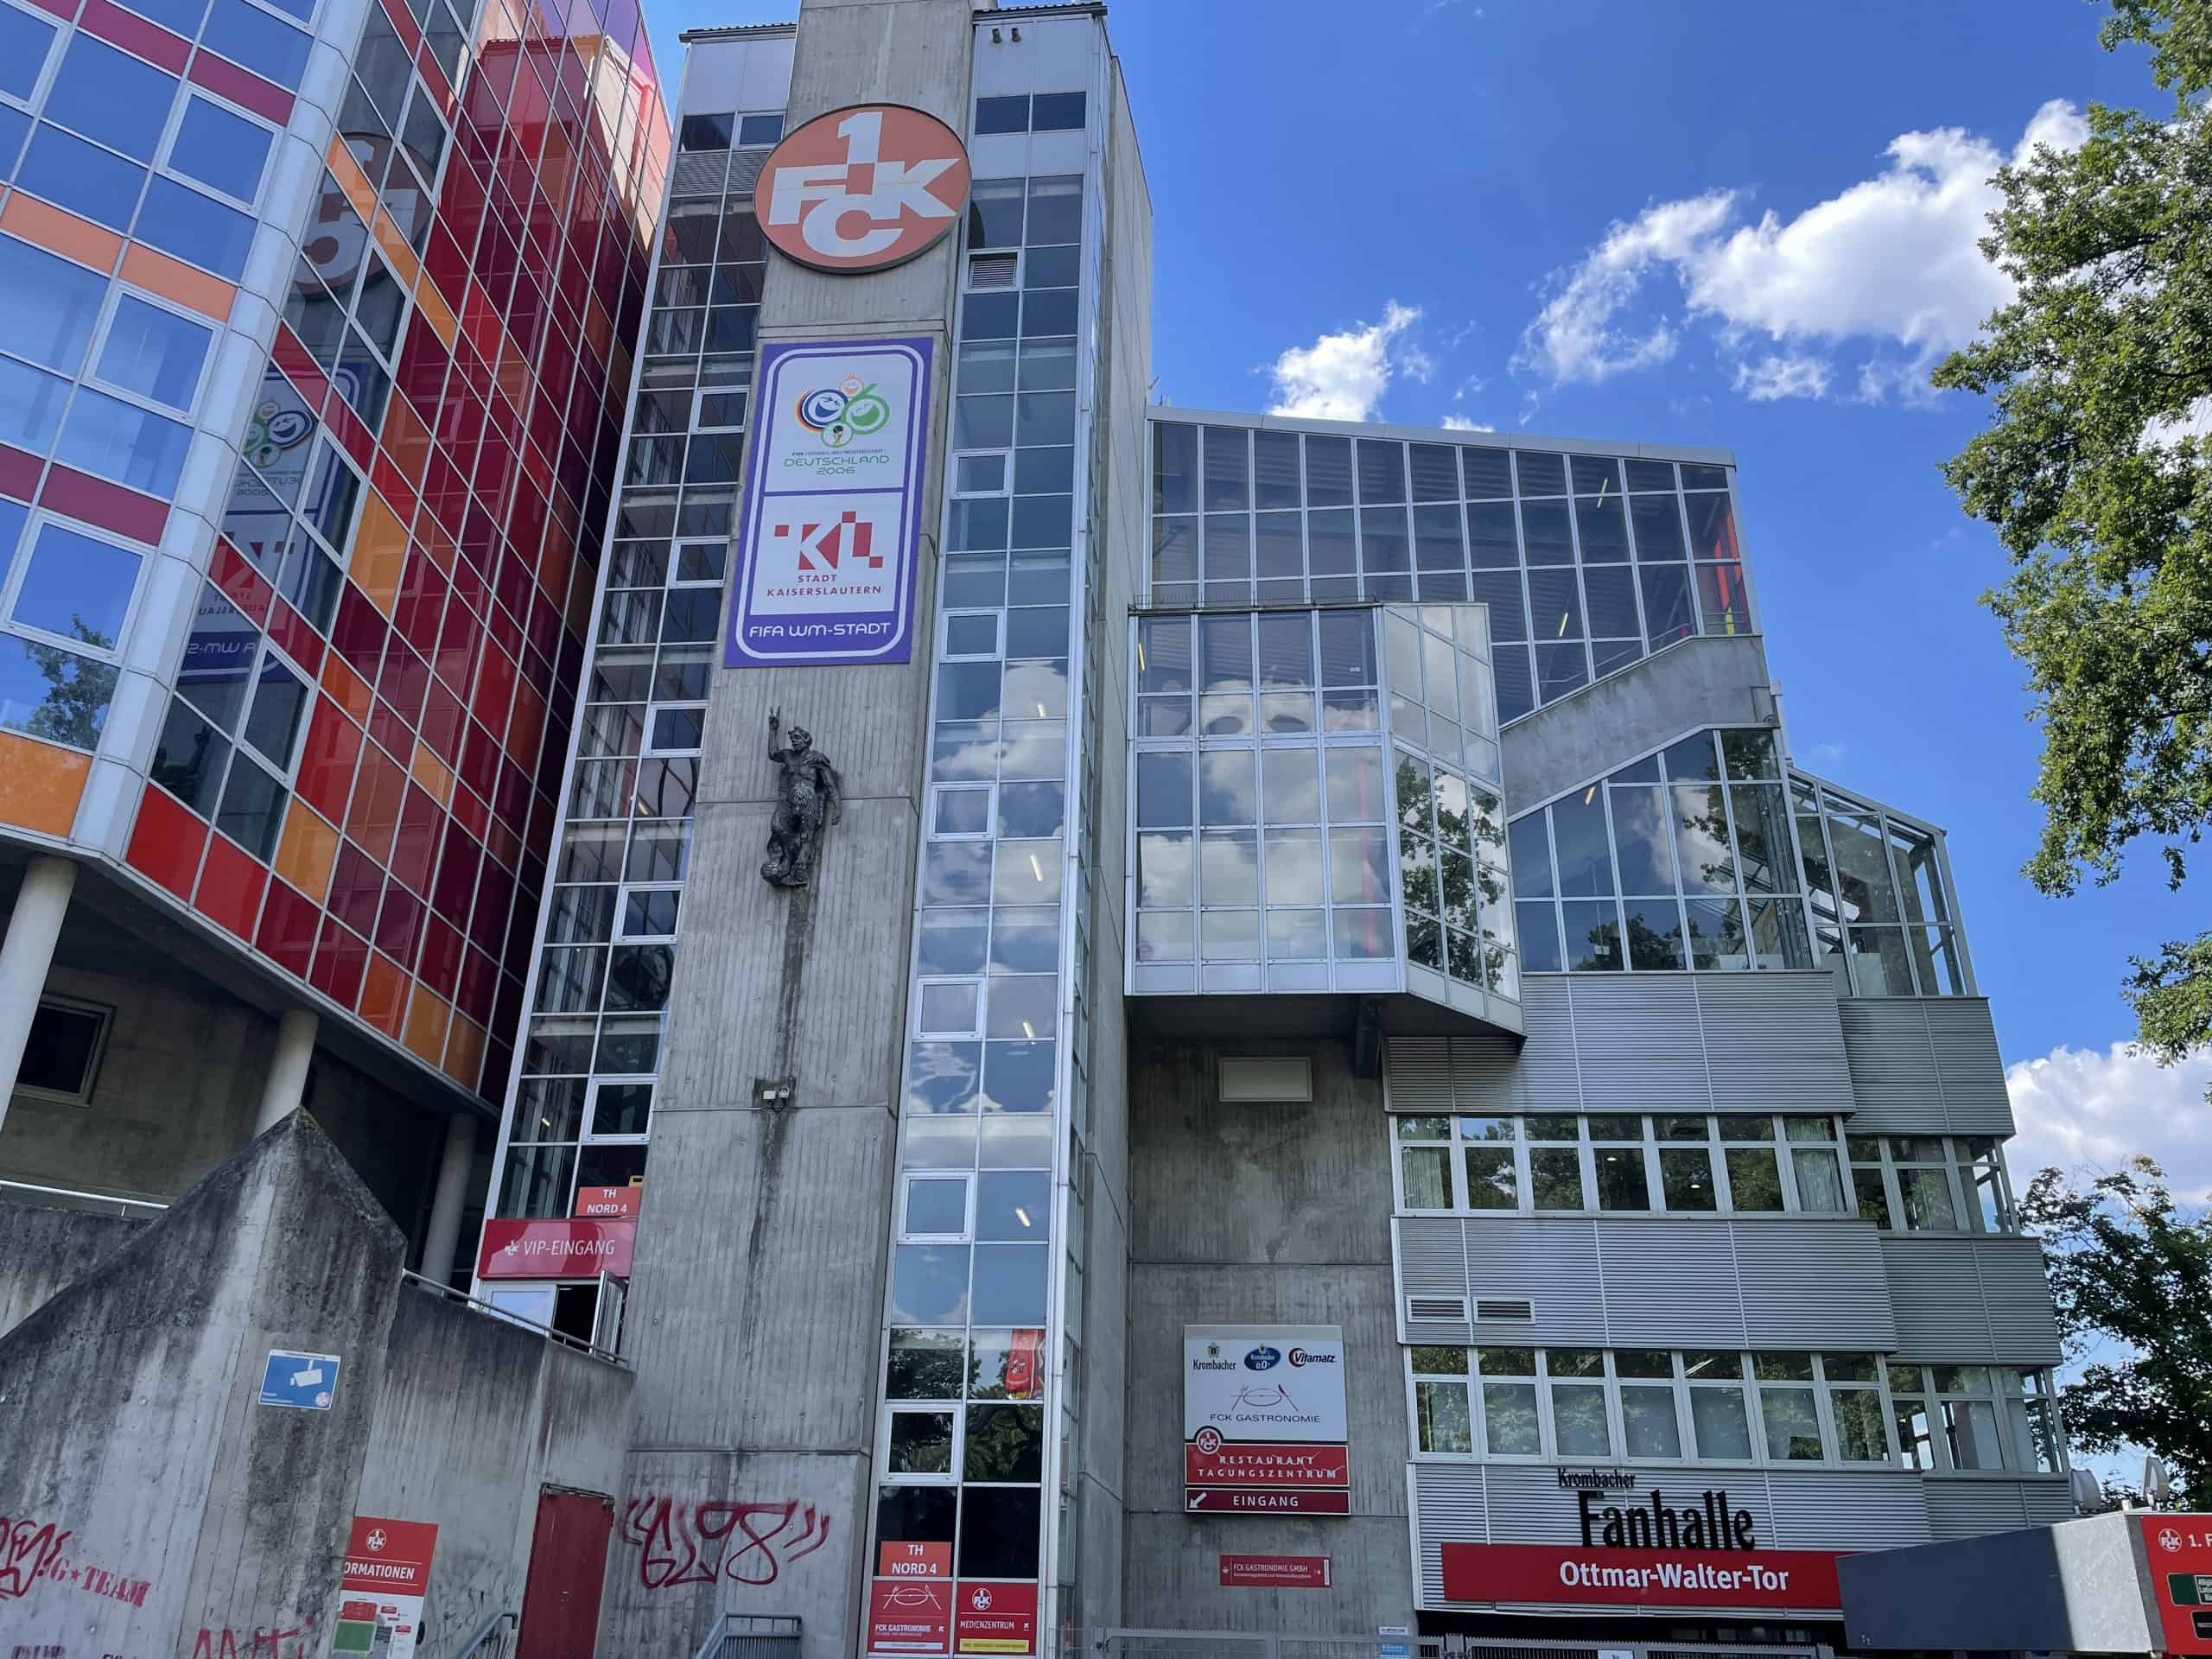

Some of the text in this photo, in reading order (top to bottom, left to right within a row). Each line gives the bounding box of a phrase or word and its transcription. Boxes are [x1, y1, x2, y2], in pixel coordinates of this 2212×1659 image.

[784, 455, 890, 467] DEUTSCHLAND
[816, 467, 855, 475] 2006
[798, 574, 837, 583] STADT
[766, 586, 882, 597] KAISERSLAUTERN
[749, 622, 891, 638] FIFA WM-STADT
[602, 1188, 617, 1198] TH
[587, 1204, 627, 1214] NORD 4
[524, 1240, 615, 1256] VIP-EINGANG
[1192, 1358, 1237, 1371] Krombacher
[1210, 1413, 1321, 1423] FCK GASTRONOMIE
[1219, 1455, 1314, 1465] RESTAURANT
[1198, 1469, 1337, 1479] TAGUNGSZENTRUM
[1557, 1468, 1636, 1488] Krombacher
[1233, 1496, 1300, 1507] EINGANG
[1577, 1489, 1756, 1551] Fanhalle
[2187, 1534, 2202, 1548] 1.
[907, 1544, 924, 1556] TH
[892, 1562, 938, 1574] NORD 4
[1560, 1560, 1789, 1591] Ottmar-Walter-Tor
[83, 1565, 151, 1608] TEAM
[960, 1620, 1015, 1630] MEDIENZENTRUM
